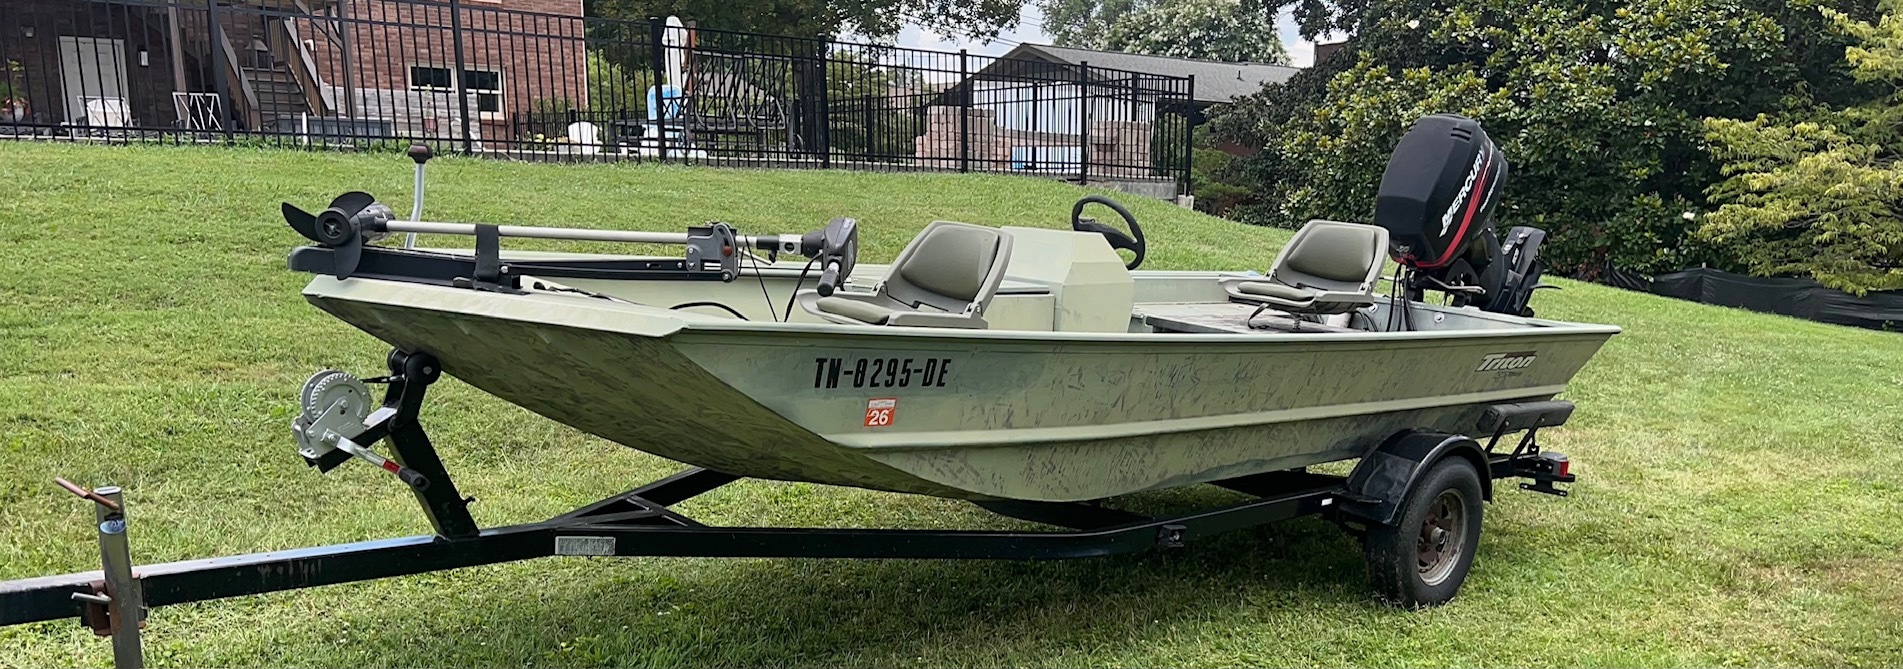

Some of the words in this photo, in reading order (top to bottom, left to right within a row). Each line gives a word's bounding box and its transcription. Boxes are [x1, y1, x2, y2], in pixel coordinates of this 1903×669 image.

[1439, 145, 1485, 237] MERCURY
[814, 357, 952, 389] TN-8295-DE
[1475, 352, 1537, 372] Triton
[868, 409, 889, 425] 26
